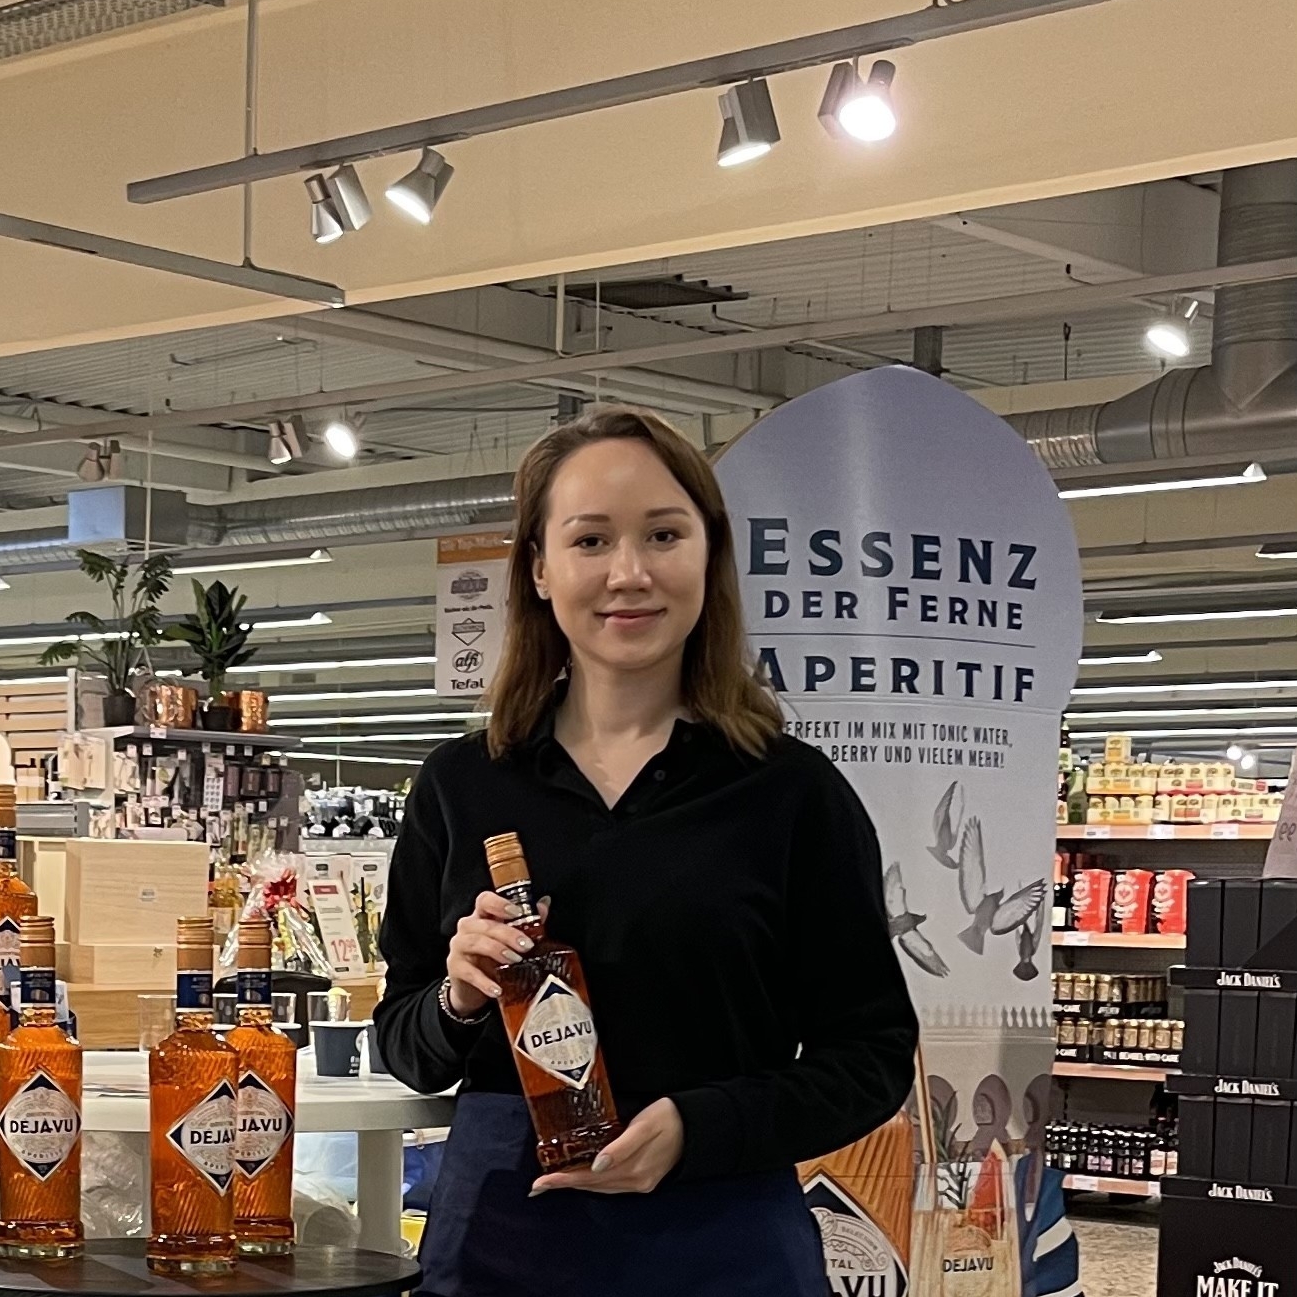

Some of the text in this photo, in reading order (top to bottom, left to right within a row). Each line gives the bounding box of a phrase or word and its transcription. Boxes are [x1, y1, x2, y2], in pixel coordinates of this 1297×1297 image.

[746, 517, 1038, 591] ESSENZ
[764, 585, 1023, 631] DER FERNE
[451, 678, 485, 690] Tefal
[755, 647, 1035, 702] APERITIF
[785, 721, 1013, 748] ERFEKT IM MIX MIT TONIC WATER,
[831, 745, 1005, 769] BERRY UND VIELEM MEHR!
[1217, 971, 1242, 987] JACK
[1214, 1078, 1240, 1095] JACK
[1208, 1183, 1234, 1199] JACK
